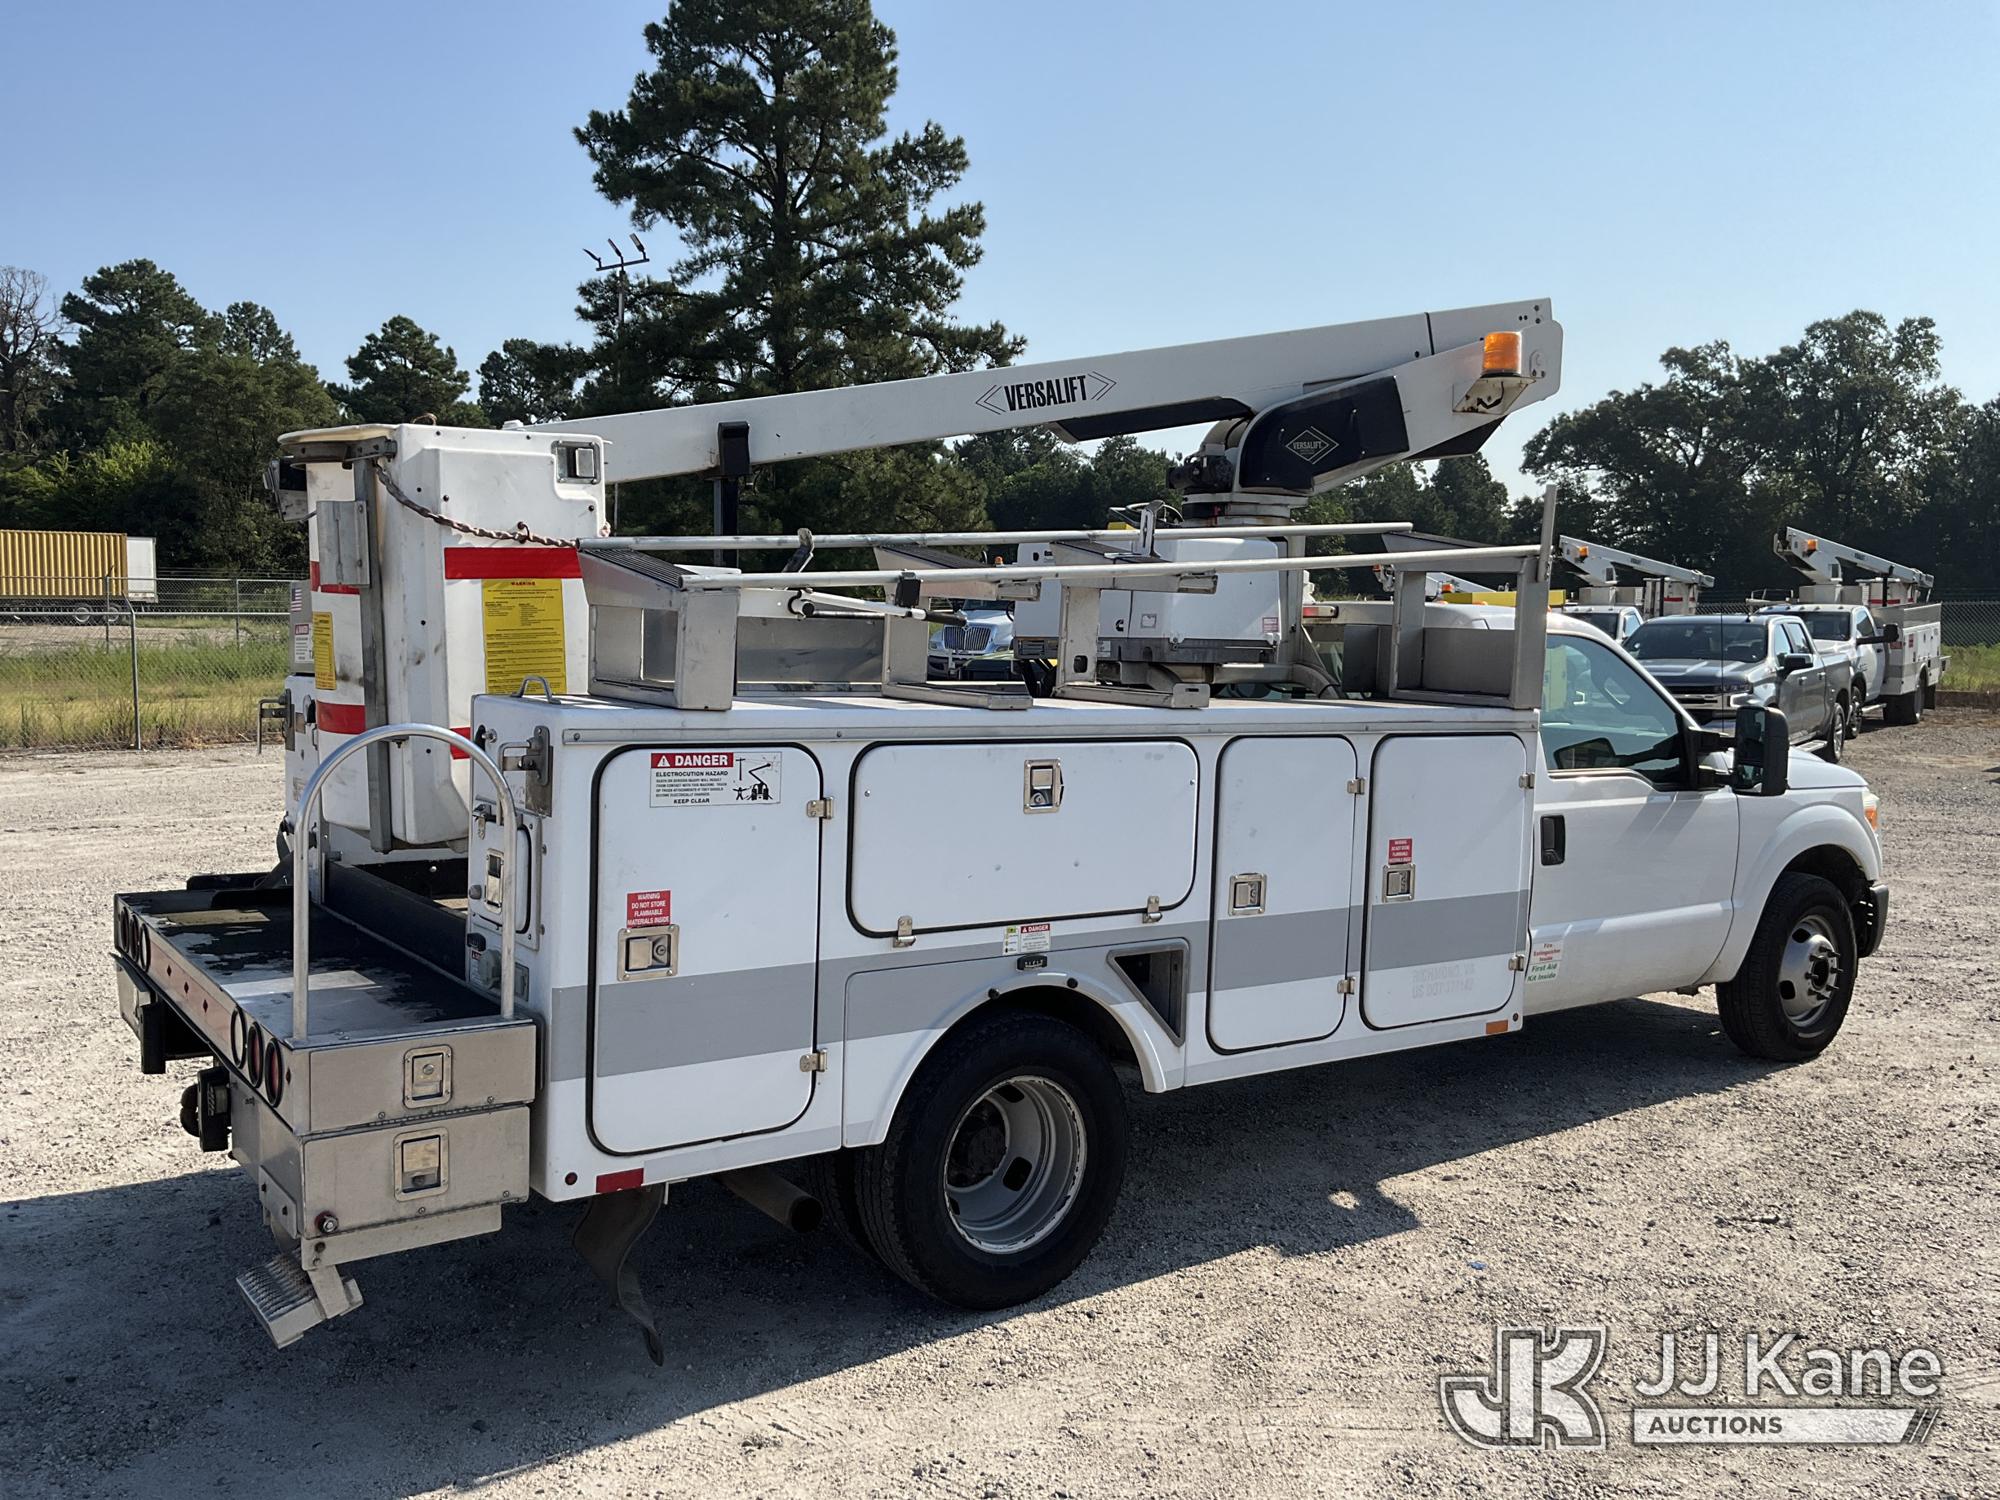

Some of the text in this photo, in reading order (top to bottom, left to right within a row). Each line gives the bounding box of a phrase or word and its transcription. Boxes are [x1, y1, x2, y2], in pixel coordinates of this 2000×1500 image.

[1004, 375, 1086, 411] VERSALIFT
[675, 754, 728, 766] DANGER
[1531, 964, 1546, 972] First
[1538, 972, 1556, 980] Inside
